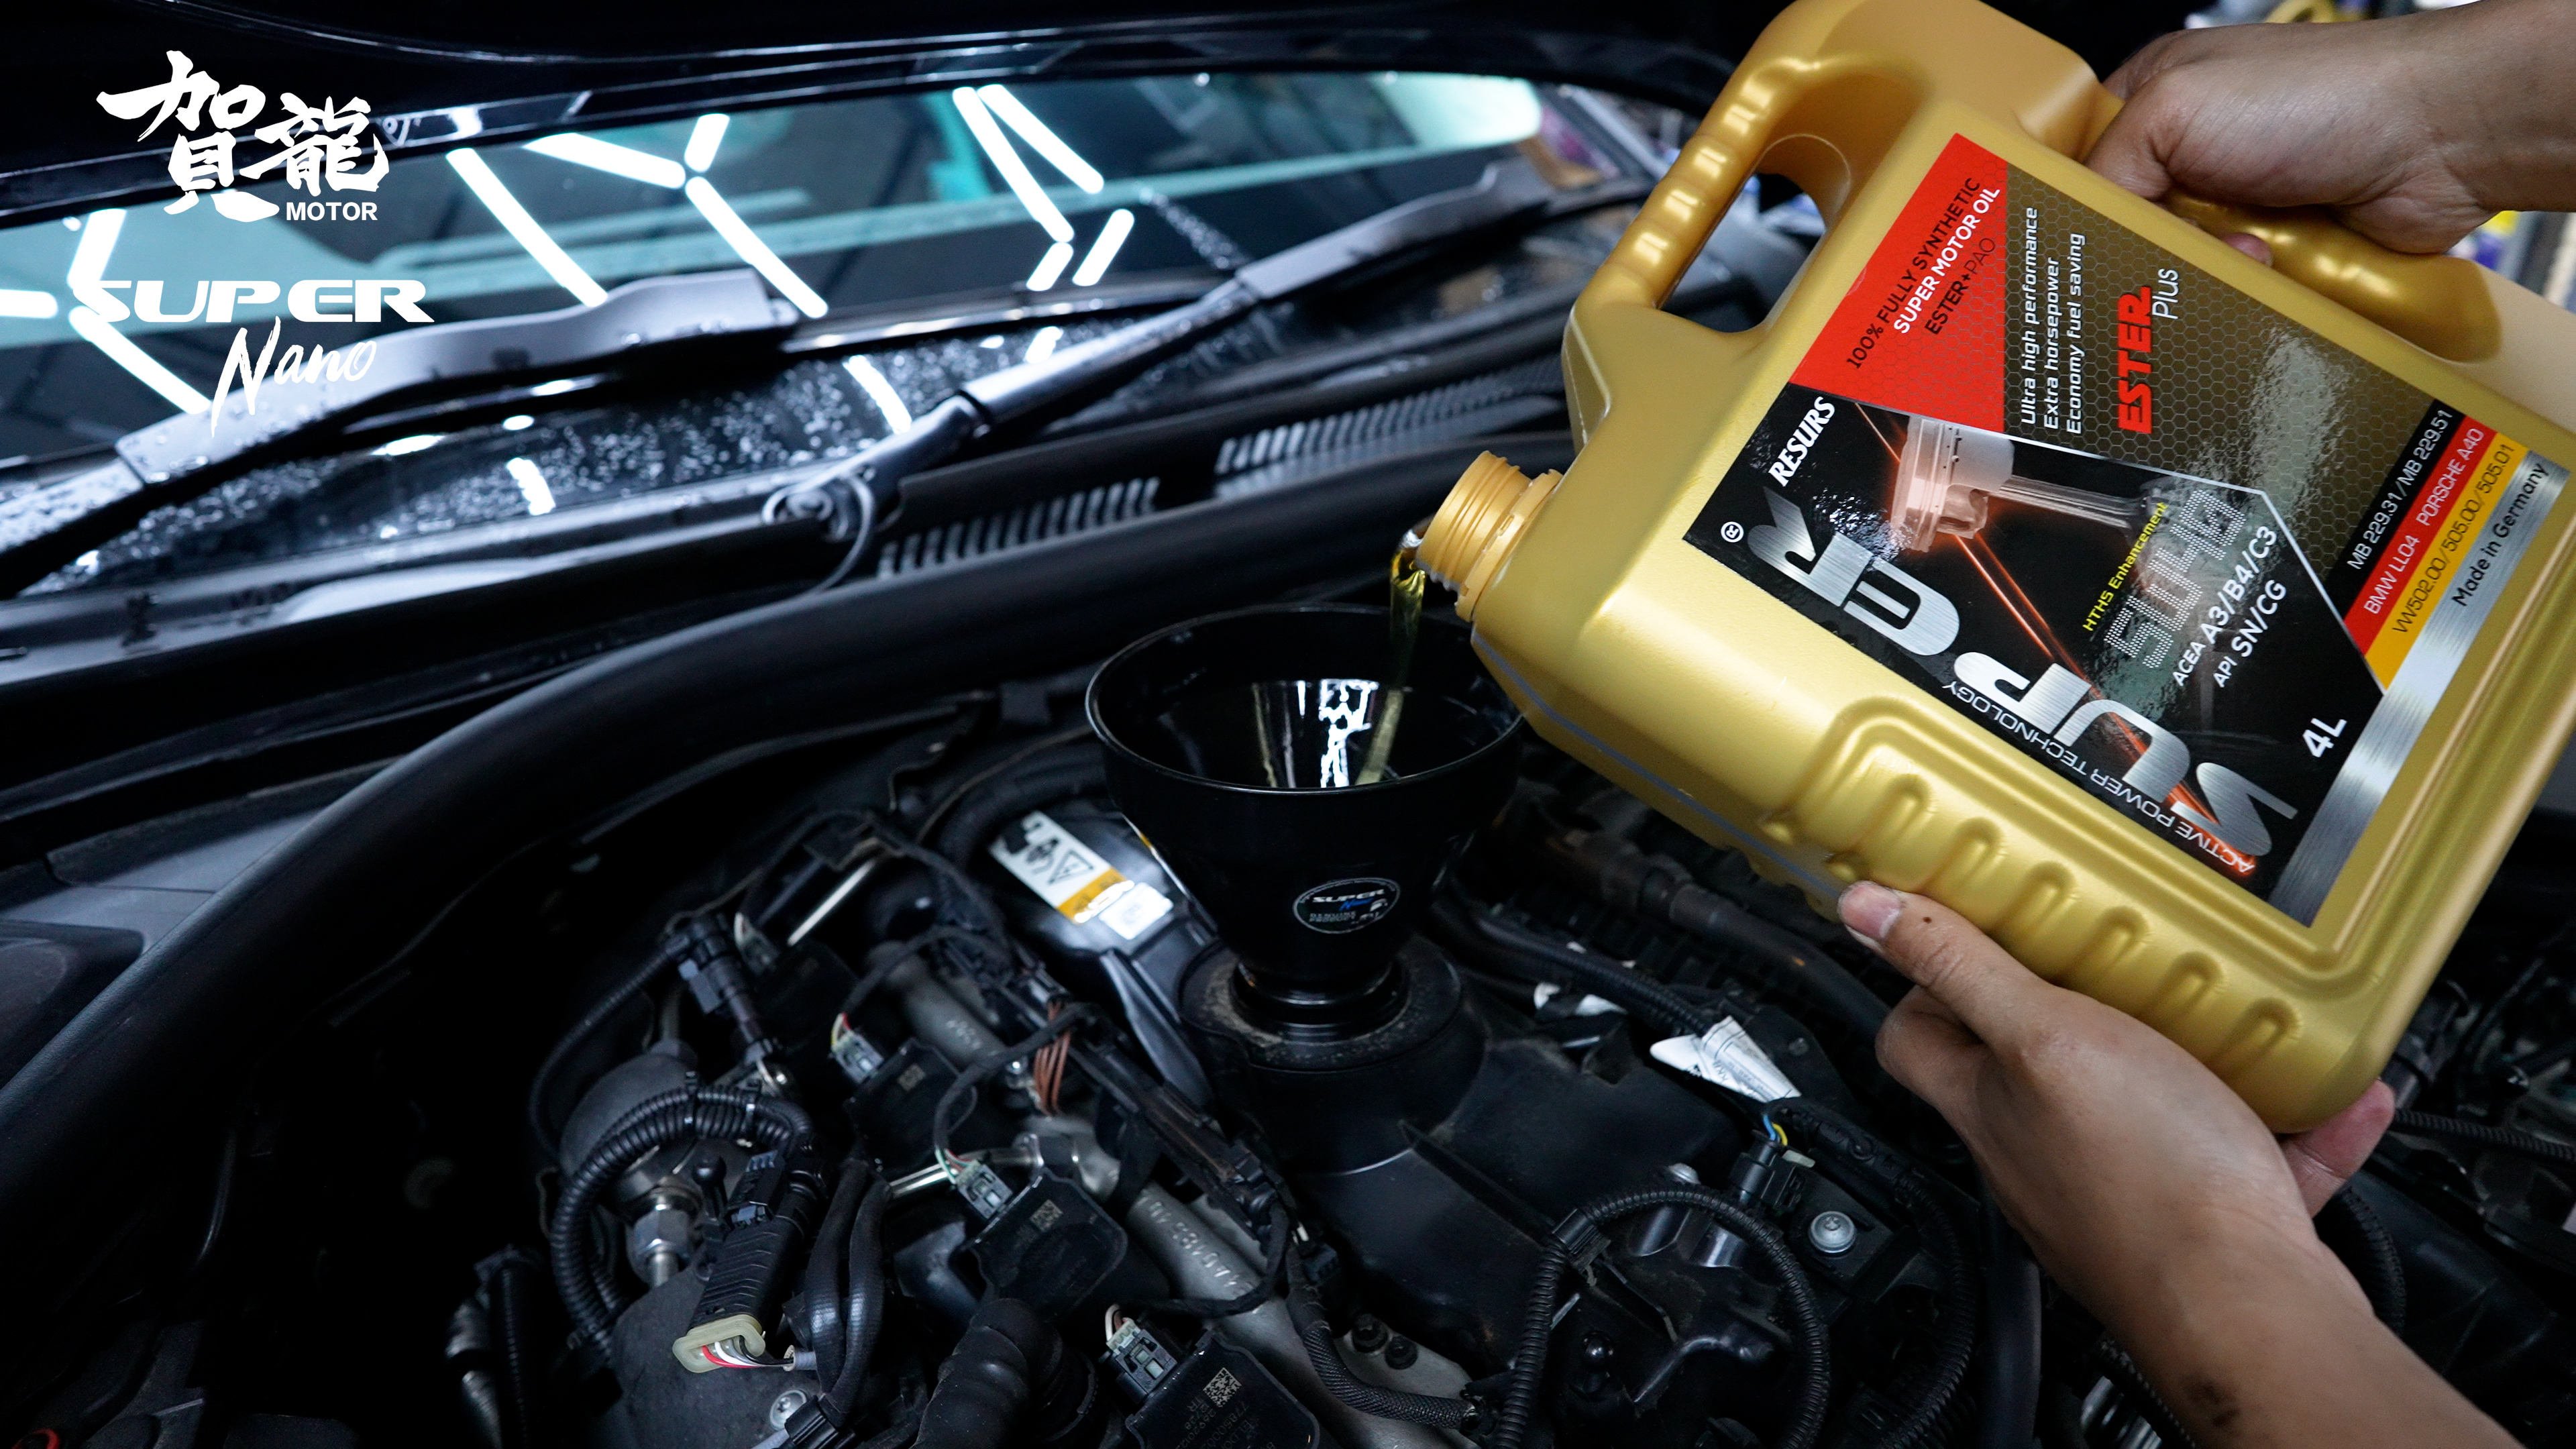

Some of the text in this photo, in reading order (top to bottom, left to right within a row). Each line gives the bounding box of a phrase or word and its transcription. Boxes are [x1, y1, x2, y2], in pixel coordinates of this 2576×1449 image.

[1845, 177, 1980, 369] 100% FULLY SYNTHETIC
[1892, 188, 2000, 333] SUPER MOTOR OIL
[1923, 237, 1994, 335] ESTER+PAO
[2020, 207, 2040, 425] Ultra high performance
[2065, 233, 2086, 434] Economy fuel saving
[2151, 268, 2179, 319] Plus
[2043, 256, 2063, 429] Extra horsepower
[2116, 286, 2152, 434] ESTER
[1767, 395, 1835, 487] RESURS
[2346, 409, 2453, 570] MB 229.31/MB 229.51
[2082, 502, 2167, 631] HTHS Enhancement
[2363, 427, 2484, 614] BMW LL04 PORSCHE A40
[2451, 462, 2549, 606] Made in Germany
[2171, 525, 2277, 686] ACEA A3/B4/C3
[2212, 579, 2286, 688] API SN/CG
[1941, 680, 2255, 873] ACTIVE POWER TECHNOLOGY
[2302, 717, 2347, 758] 4L
